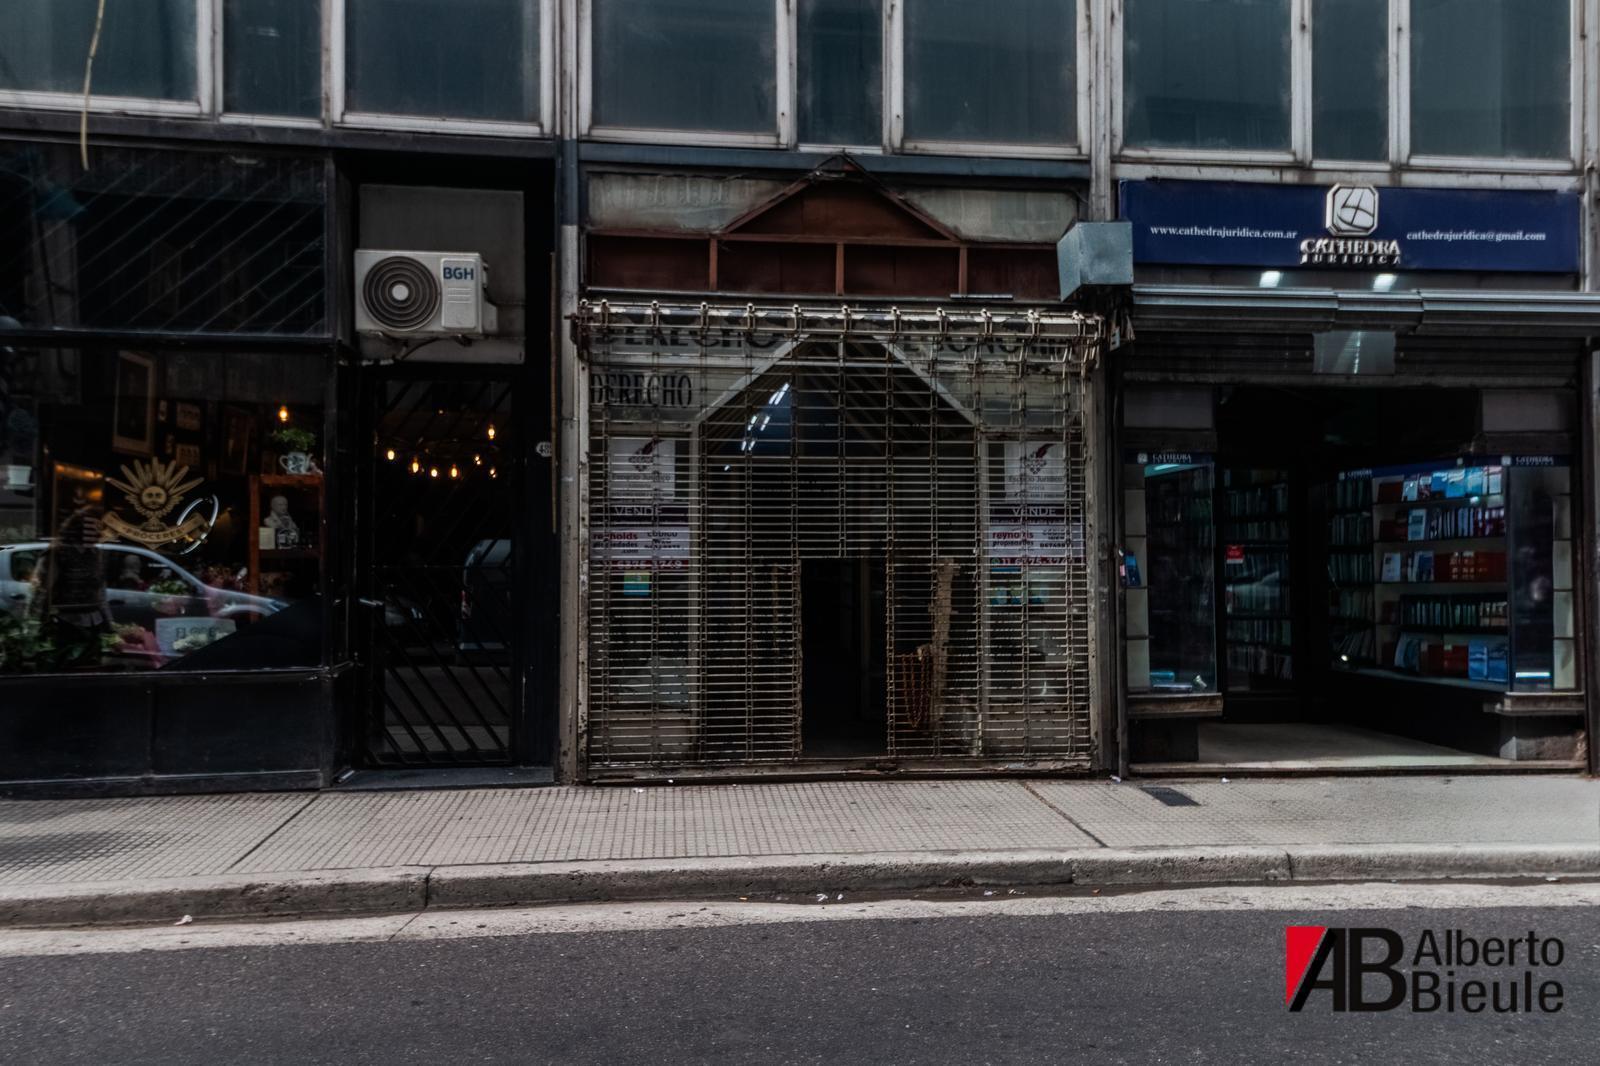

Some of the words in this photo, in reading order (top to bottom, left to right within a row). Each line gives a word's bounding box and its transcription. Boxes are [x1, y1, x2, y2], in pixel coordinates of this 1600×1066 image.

[1150, 226, 1298, 240] www.cathedrajuridica.com.ar
[1406, 230, 1547, 243] cathedrajuridica@gmail.com
[1299, 238, 1402, 254] CATHEDRA
[1299, 253, 1402, 265] JURIDICA
[443, 267, 475, 281] BGH
[590, 374, 693, 407] DERECHO
